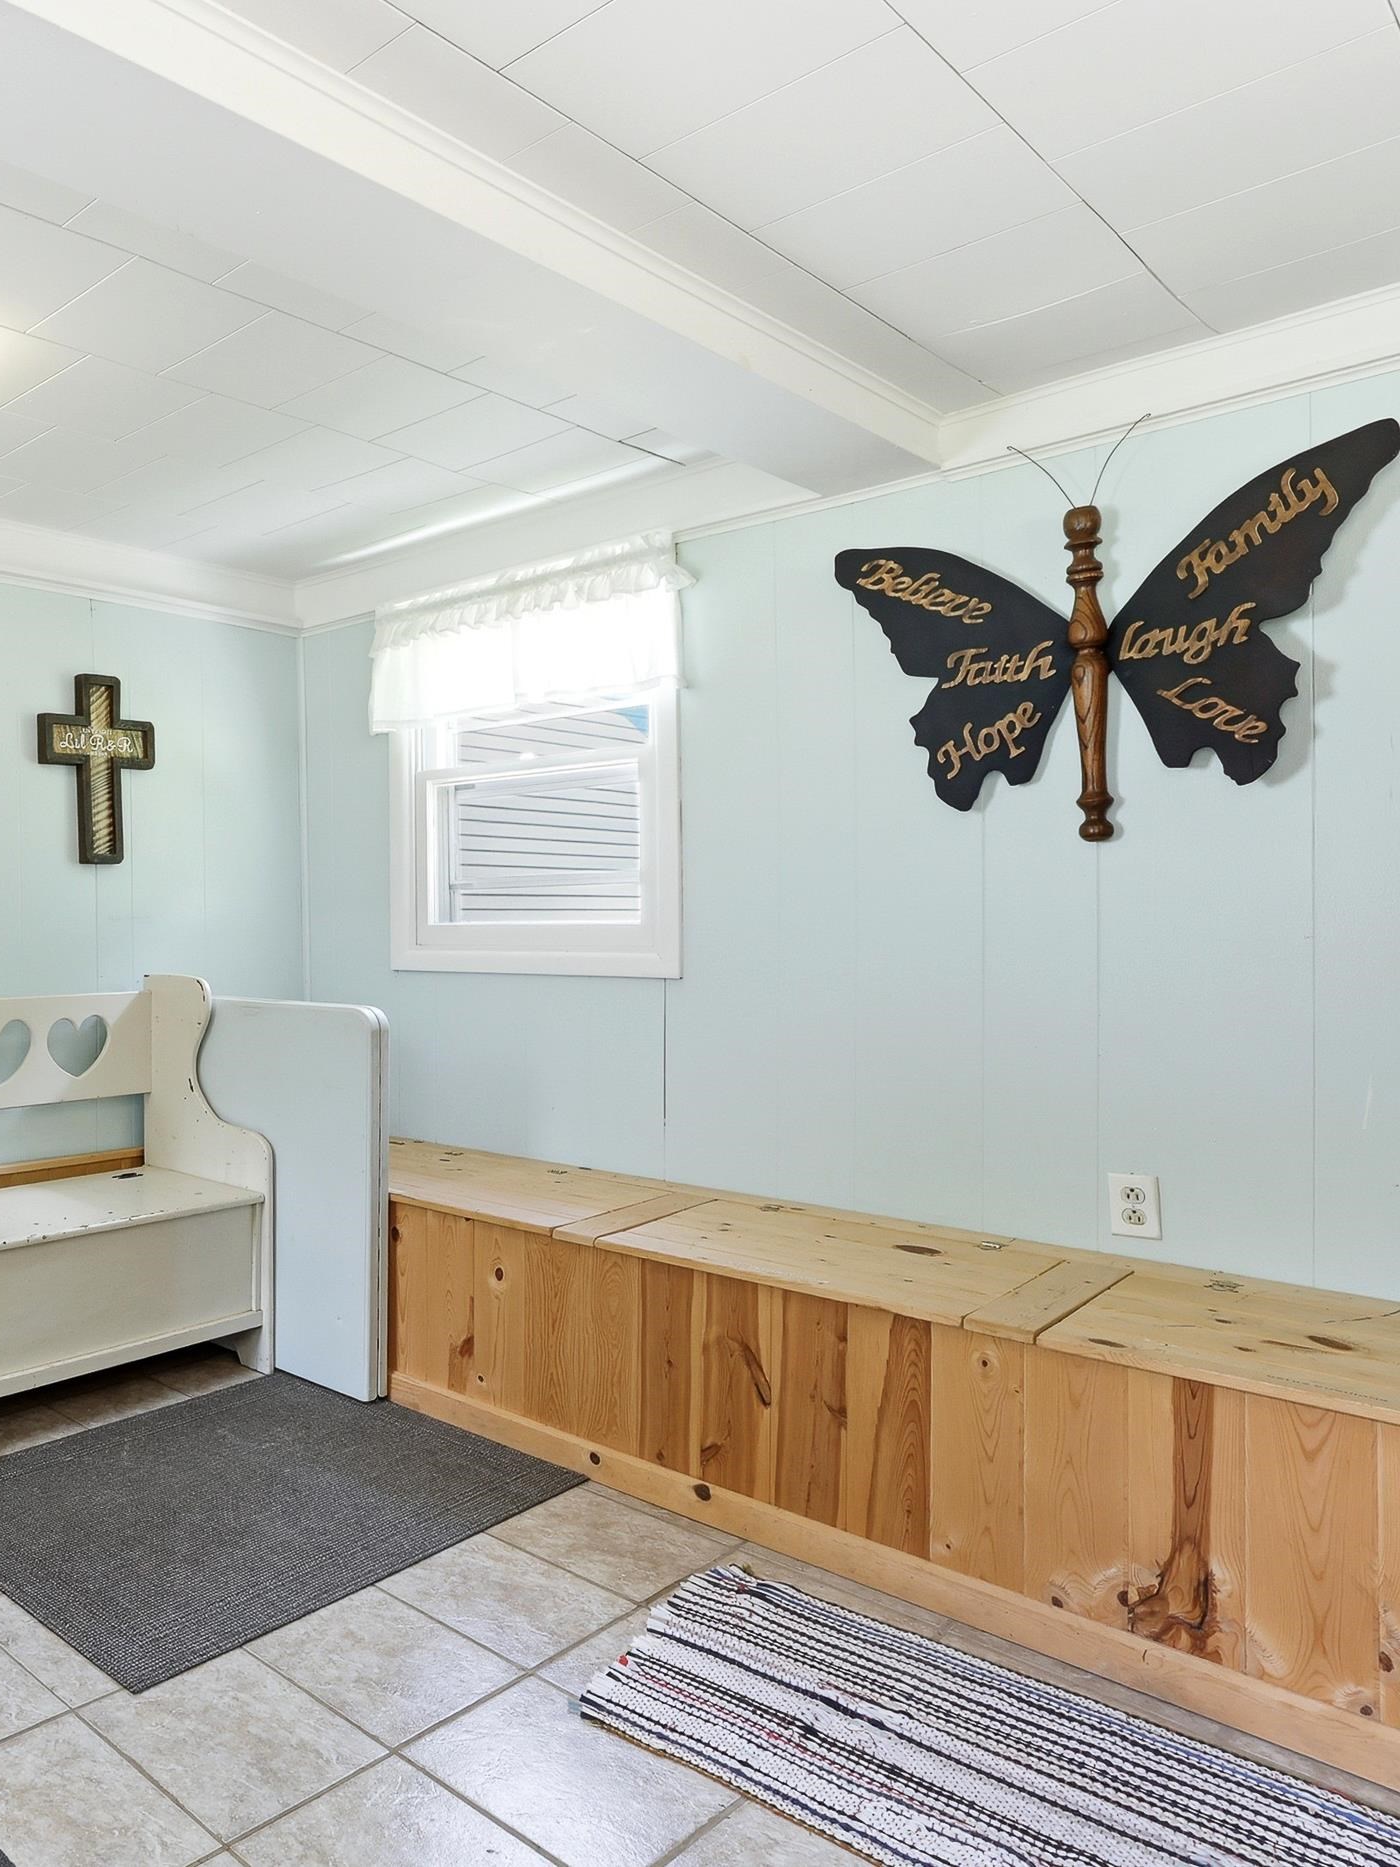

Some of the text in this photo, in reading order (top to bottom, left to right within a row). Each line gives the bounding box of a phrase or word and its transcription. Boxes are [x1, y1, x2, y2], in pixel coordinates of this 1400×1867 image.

[1175, 467, 1339, 600] Family
[856, 559, 993, 624] Believe
[941, 640, 1057, 689] Faith
[937, 701, 1042, 780] Hope
[1156, 677, 1269, 744] Love
